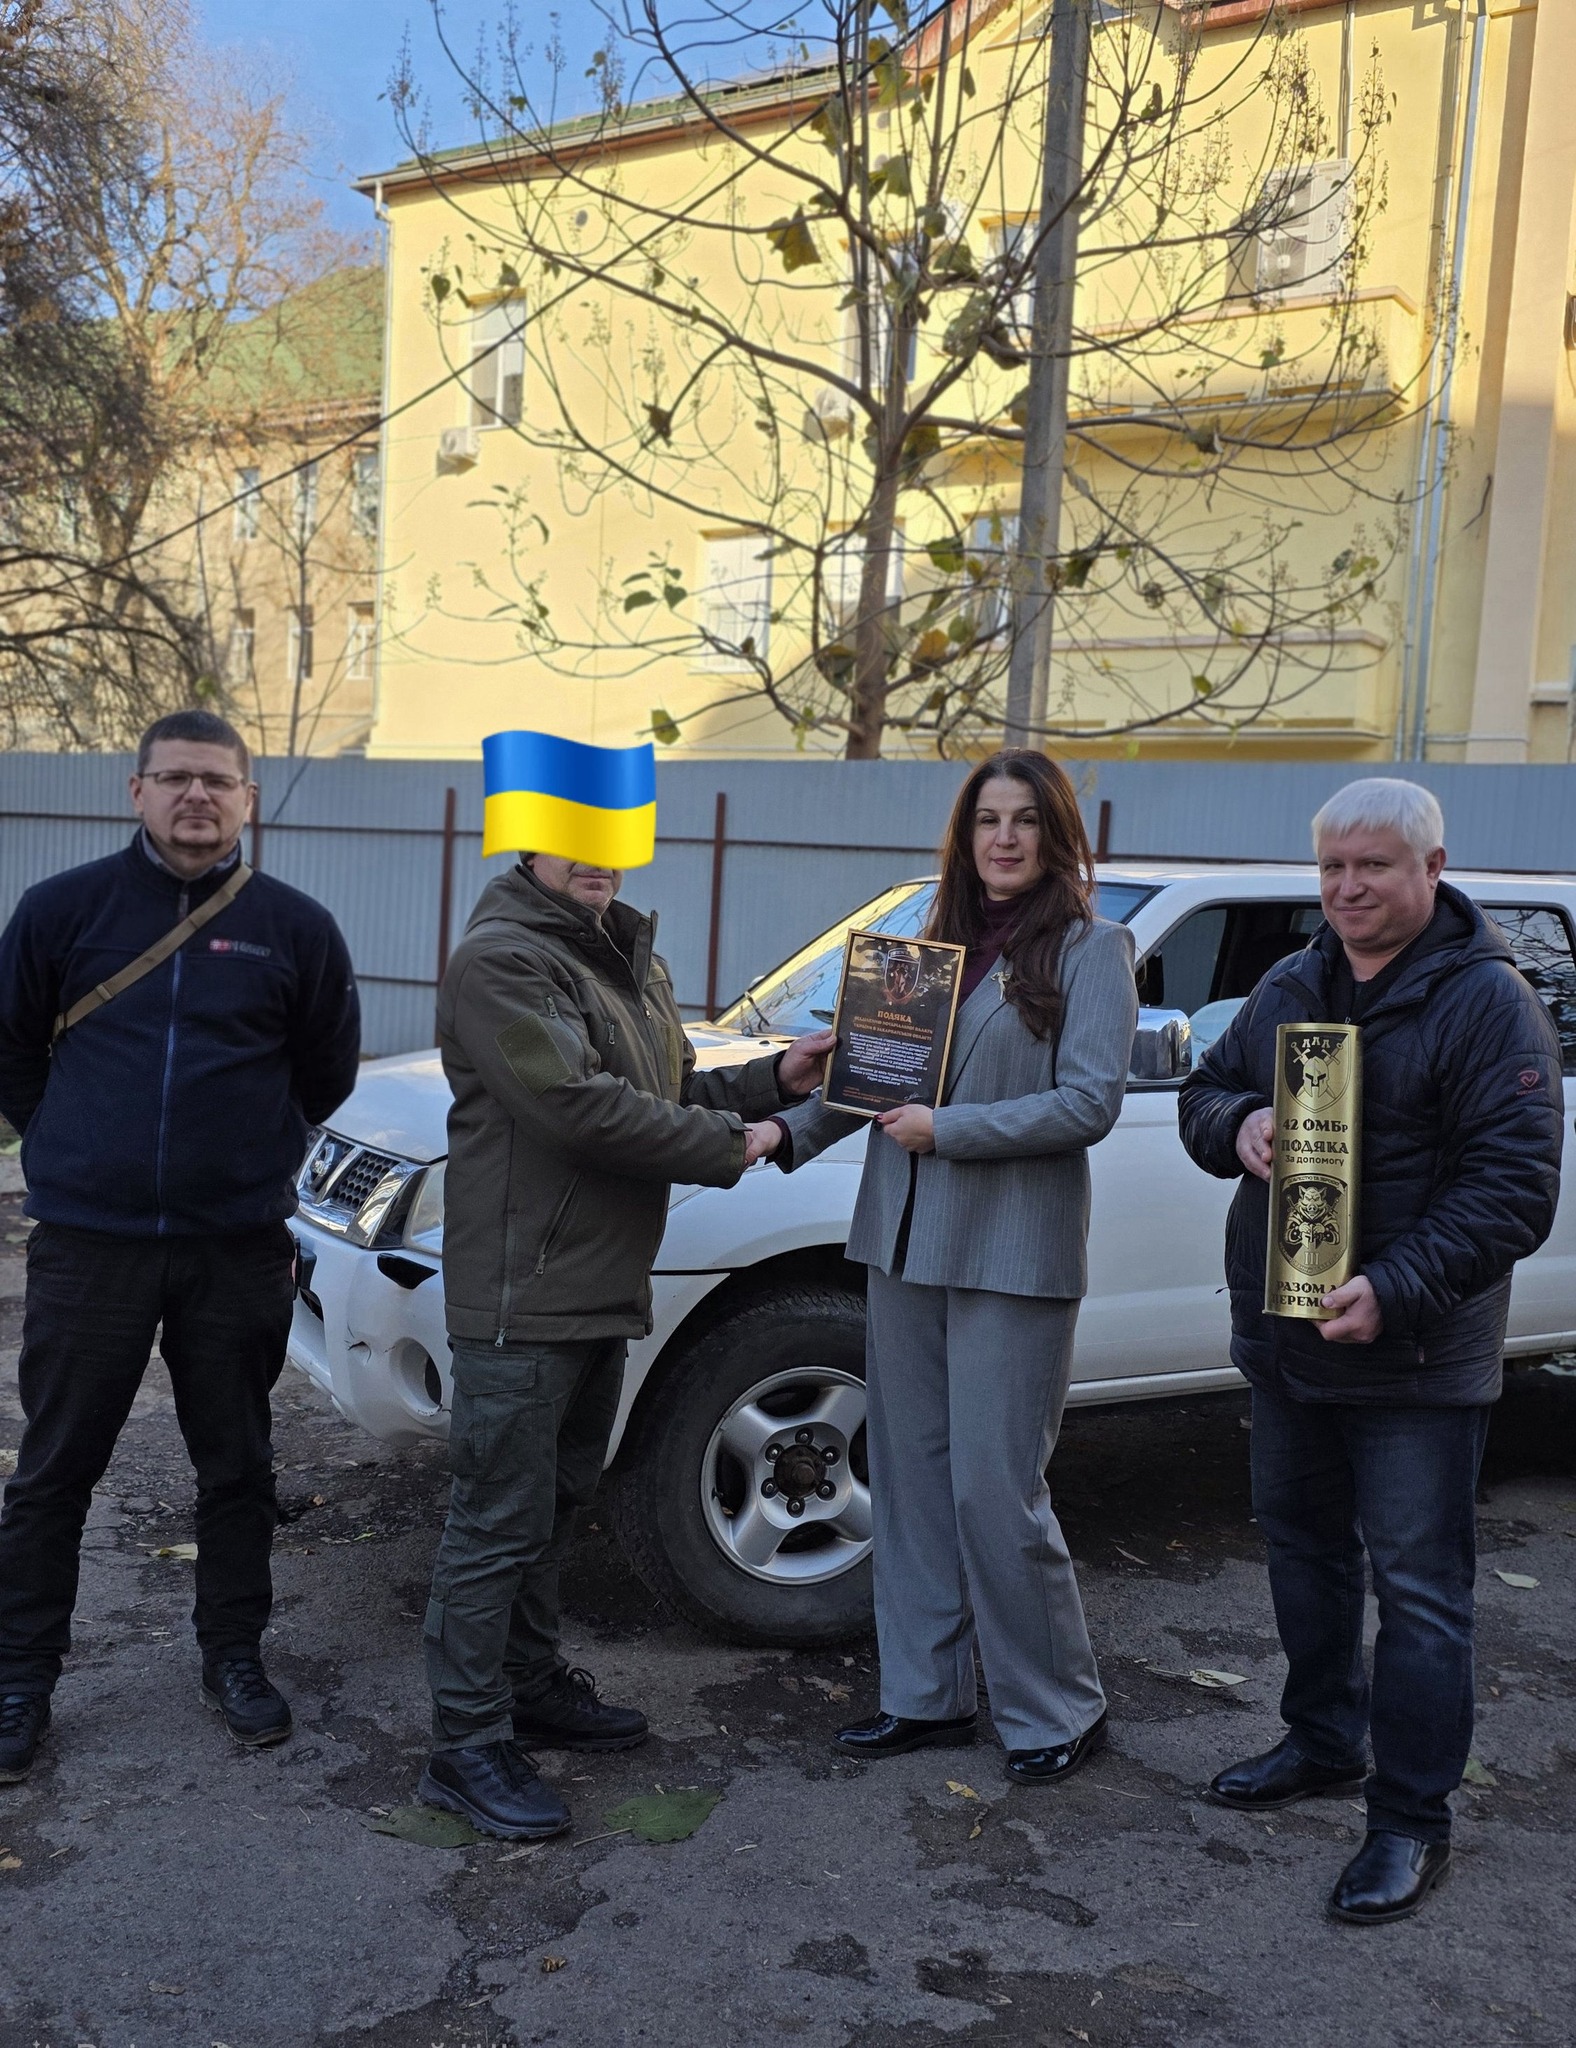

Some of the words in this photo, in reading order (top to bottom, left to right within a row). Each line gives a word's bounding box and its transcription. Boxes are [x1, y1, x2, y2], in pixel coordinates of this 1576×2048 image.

[877, 1010, 912, 1024] ПОДЯКА
[1282, 1118, 1299, 1131] 42
[1303, 1118, 1349, 1133] ОМБр
[1281, 1139, 1349, 1154] ПОДЯКА
[1286, 1154, 1295, 1163] За
[1296, 1157, 1345, 1167] допомогу
[1277, 1280, 1325, 1294] РАЗОМ
